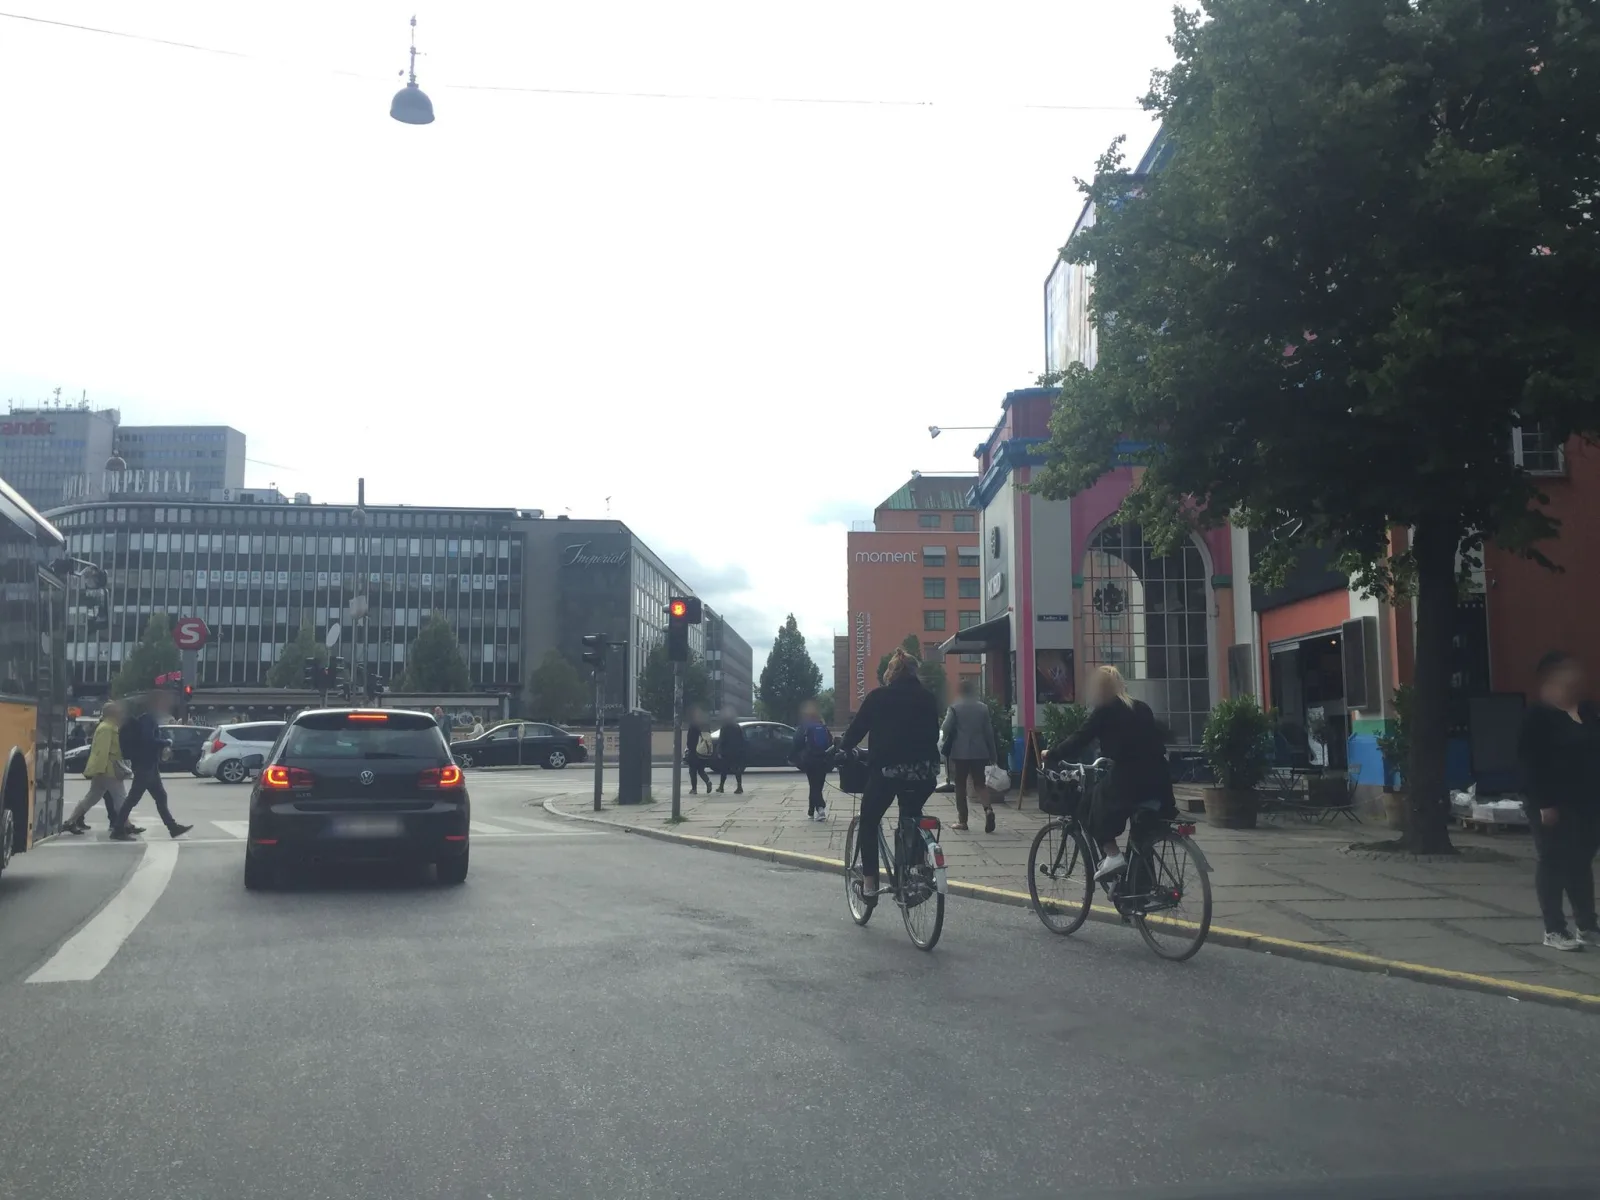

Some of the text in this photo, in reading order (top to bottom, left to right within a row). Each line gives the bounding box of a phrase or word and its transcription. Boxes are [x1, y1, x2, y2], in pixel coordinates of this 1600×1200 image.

[101, 470, 195, 493] IMPERIAL
[564, 540, 628, 568] Imperial
[855, 551, 918, 563] moment
[179, 623, 200, 644] S
[856, 611, 865, 701] AKADEMIKERNES
